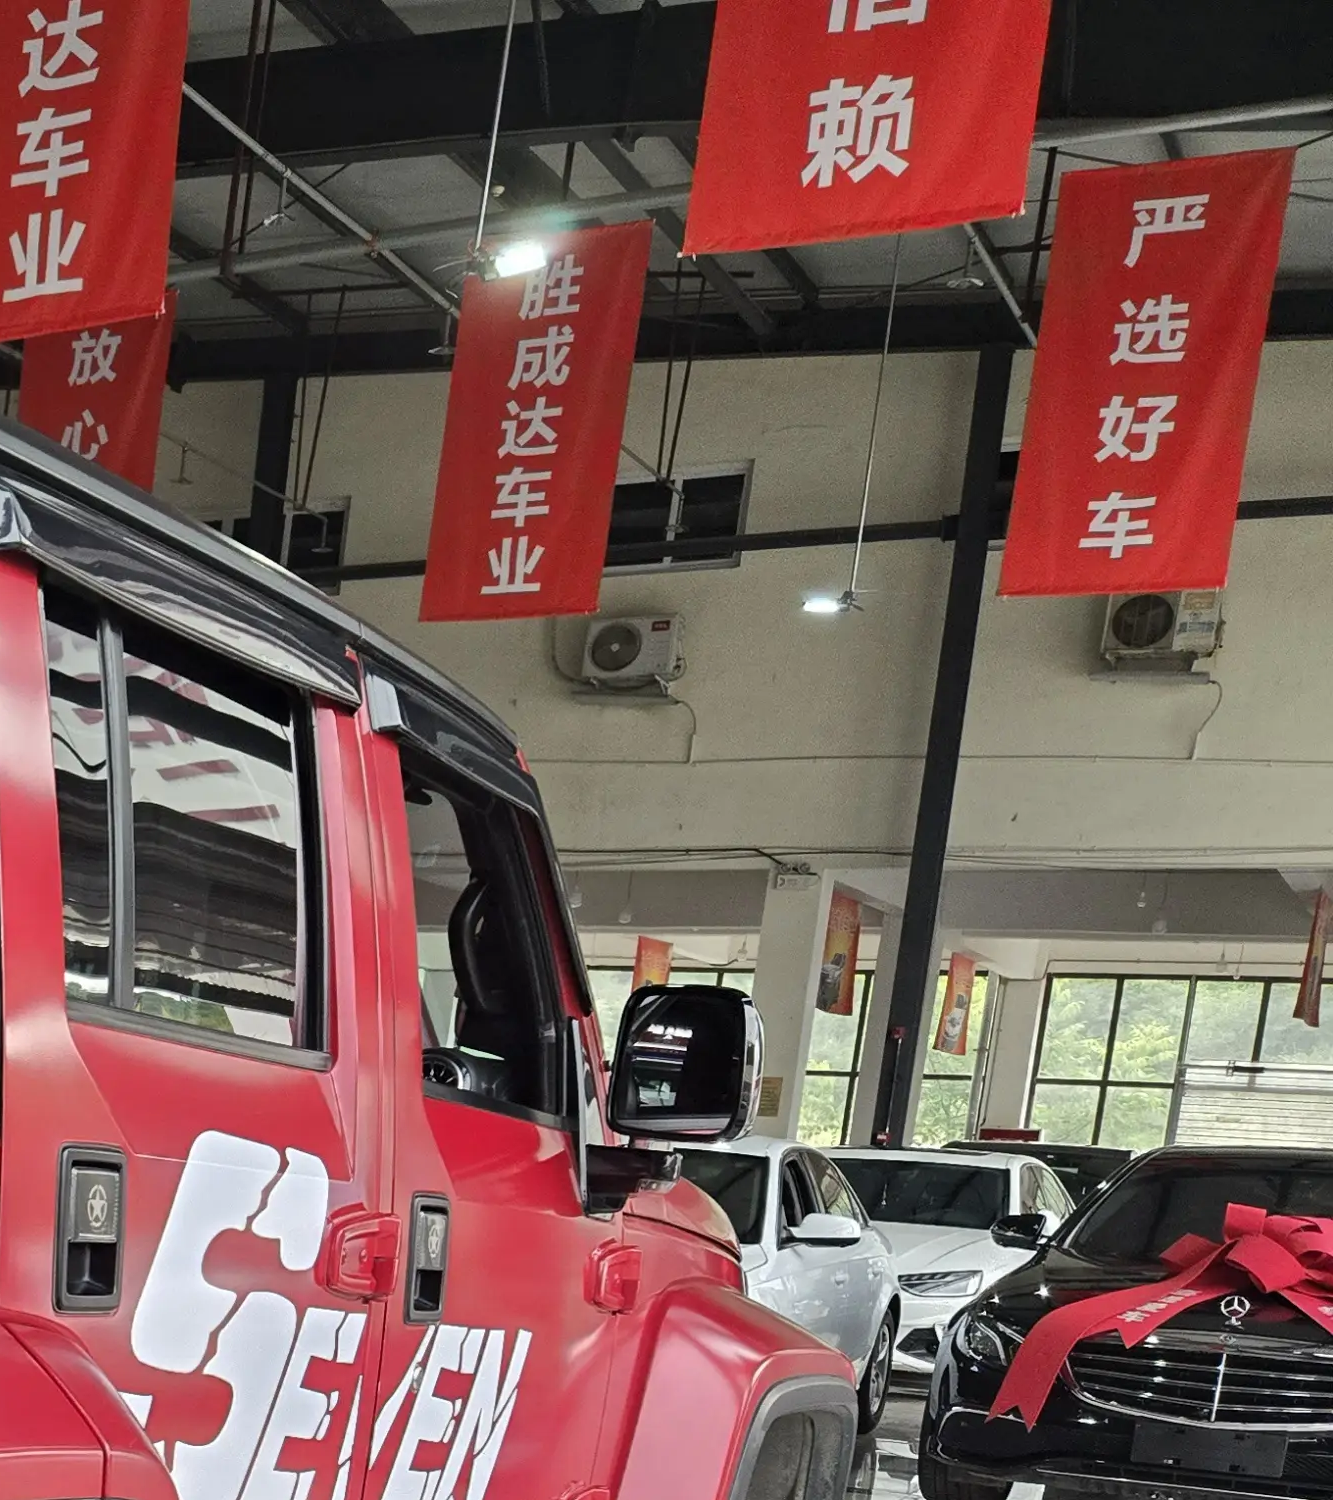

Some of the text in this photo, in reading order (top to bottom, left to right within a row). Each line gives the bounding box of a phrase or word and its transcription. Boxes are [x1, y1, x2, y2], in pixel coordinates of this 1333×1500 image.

[2, 0, 103, 303] 达车业
[61, 328, 122, 460] 放心
[480, 252, 585, 596] 胜成达车业
[1077, 193, 1211, 559] 严选好车
